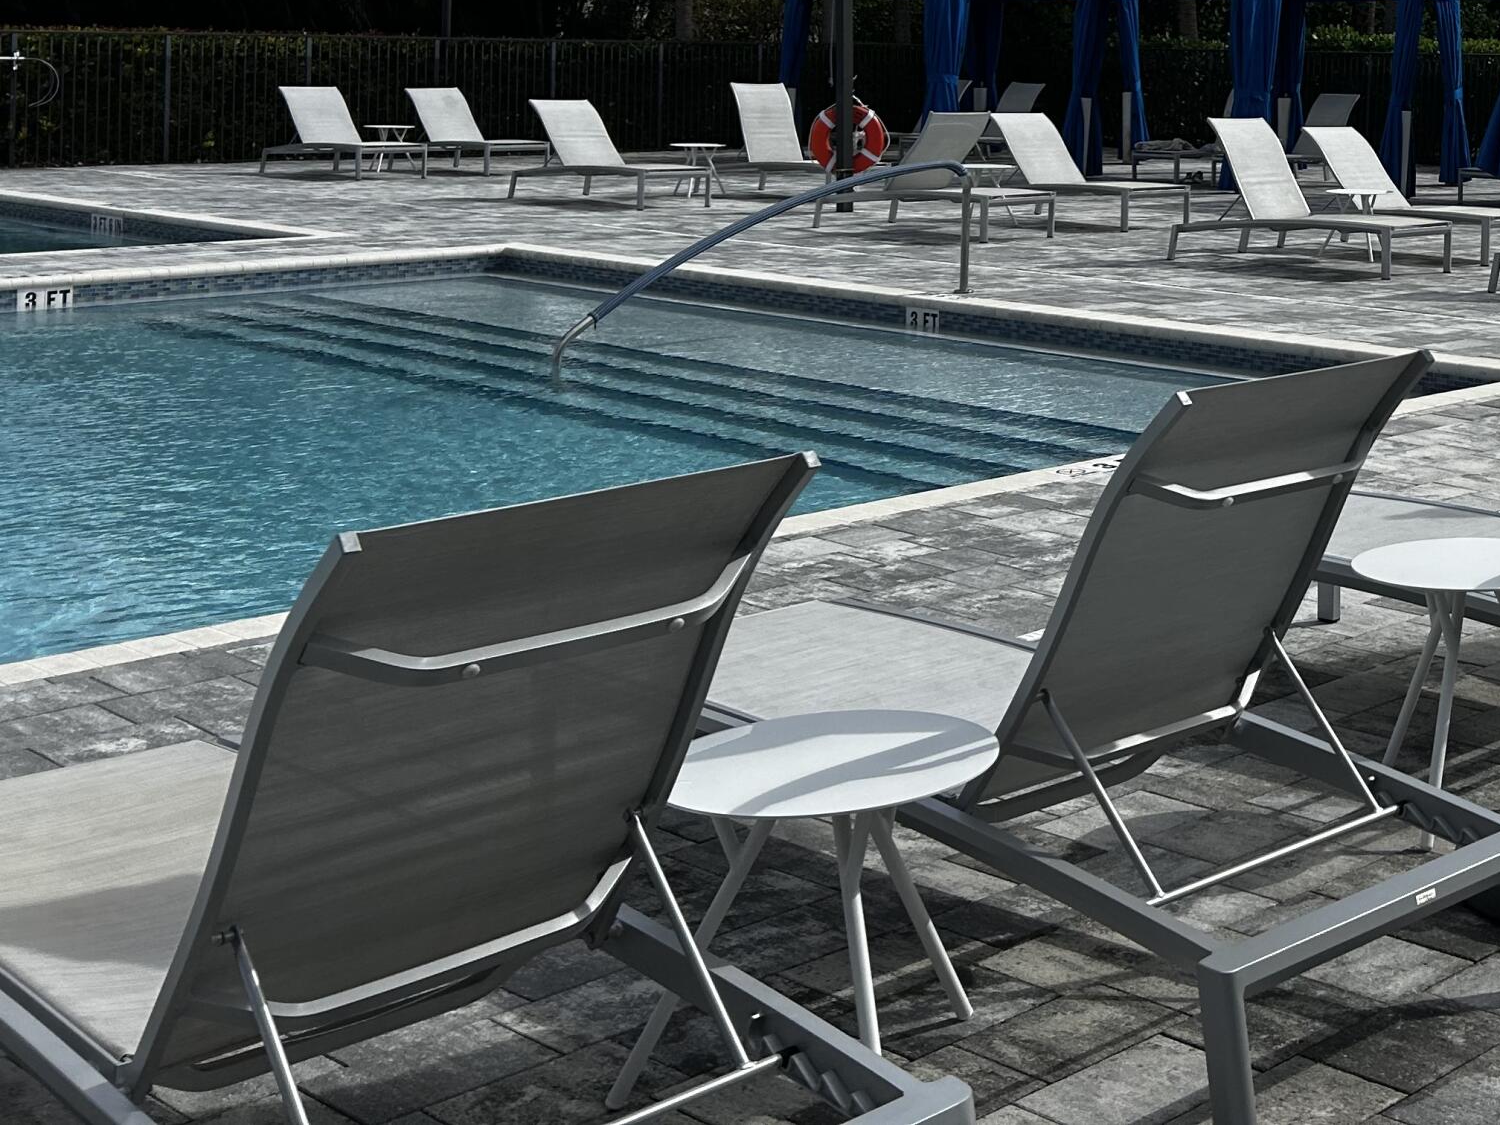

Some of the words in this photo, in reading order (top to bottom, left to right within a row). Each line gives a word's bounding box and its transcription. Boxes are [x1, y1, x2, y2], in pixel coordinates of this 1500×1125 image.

[25, 292, 37, 308] 3
[47, 289, 70, 308] FT
[910, 311, 918, 328] 3
[923, 312, 938, 331] FT
